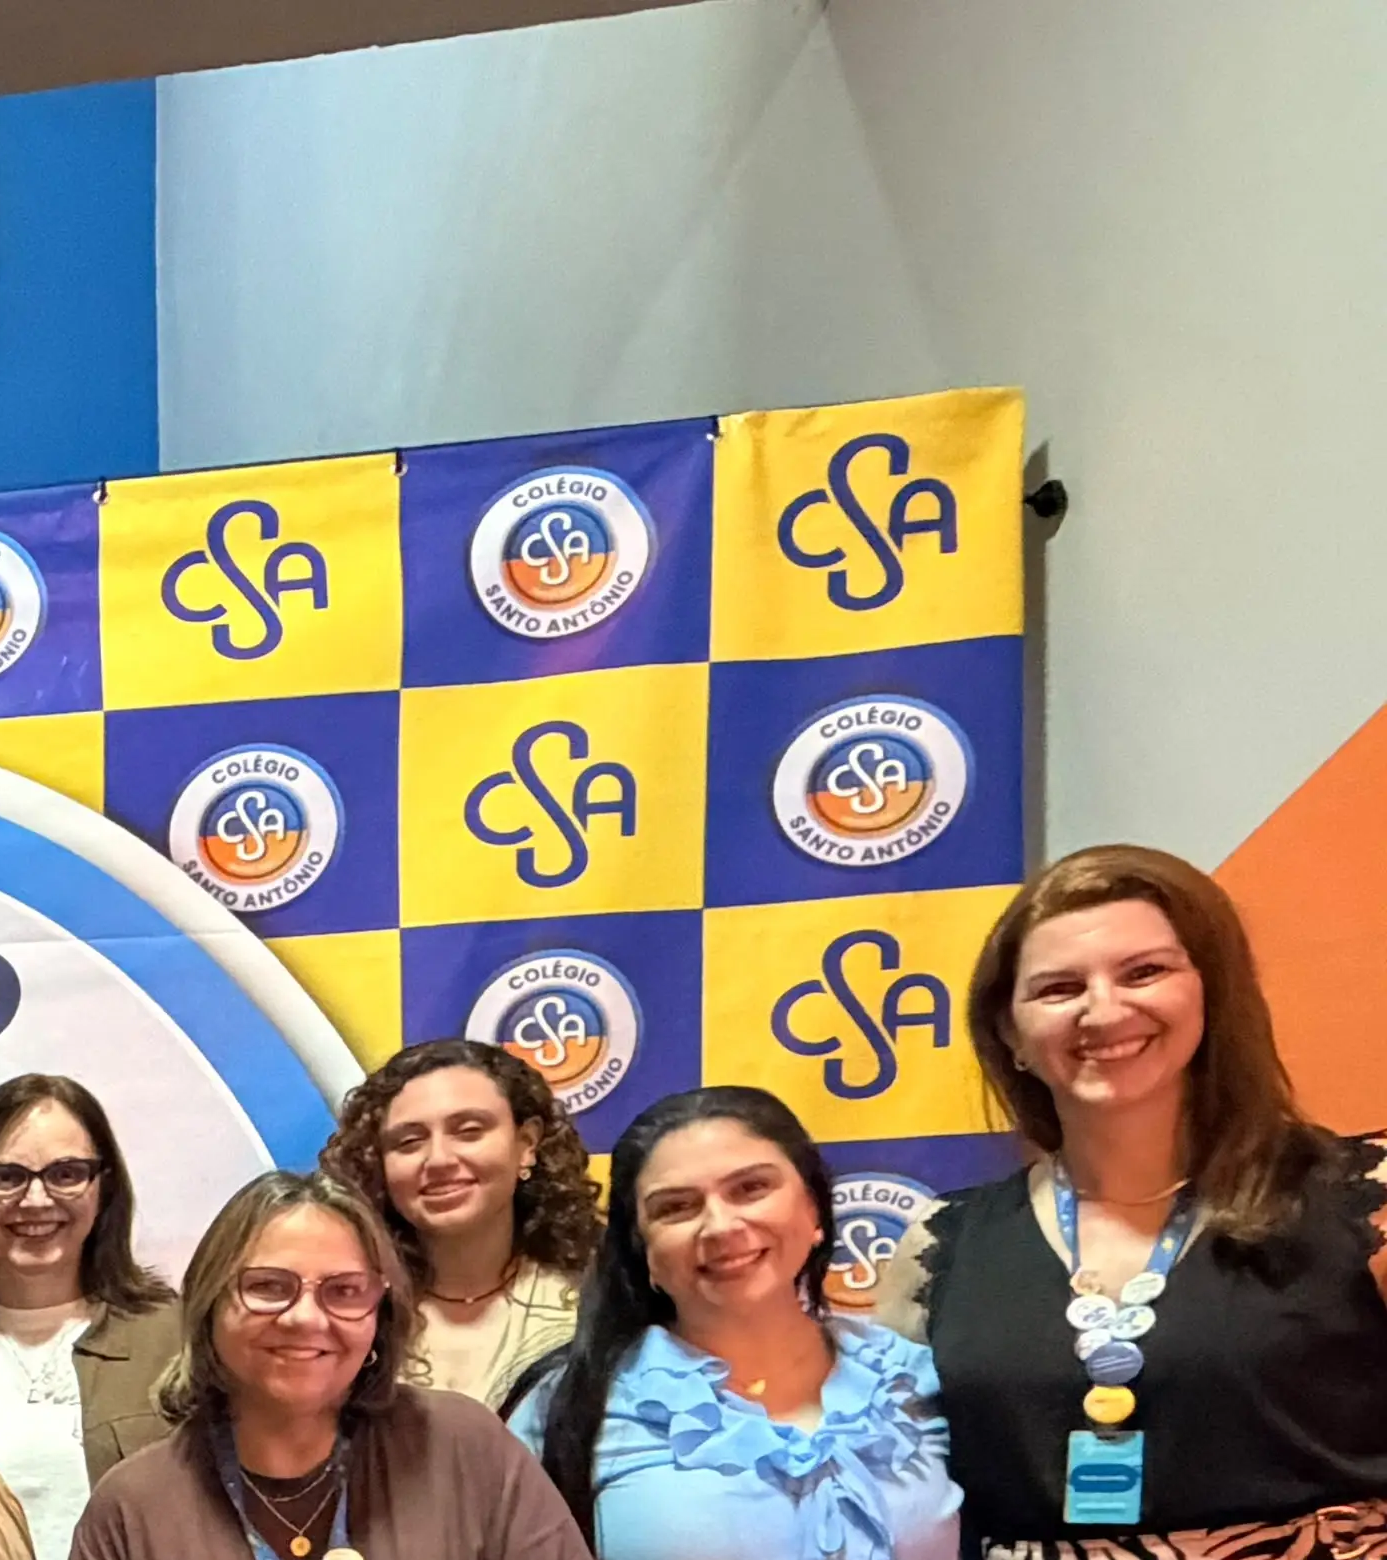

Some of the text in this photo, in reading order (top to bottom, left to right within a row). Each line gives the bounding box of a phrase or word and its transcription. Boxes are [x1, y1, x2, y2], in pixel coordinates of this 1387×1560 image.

[512, 477, 607, 508] COLÉGIO
[777, 433, 958, 611] CSA
[161, 499, 329, 660] CSA
[485, 570, 634, 633] SANTO ANTÔNIO
[820, 706, 922, 738] COLÉGIO
[211, 754, 300, 784] COLÉGIO
[464, 720, 637, 889] CSA
[789, 801, 951, 862] SANTO ANTÔNIO
[243, 851, 323, 908] ANTÔNIO
[508, 960, 601, 989] COLÉGIO
[770, 928, 951, 1100] CSA
[564, 1057, 623, 1110] NTÔNIO
[832, 1184, 916, 1210] OLÉGIO
